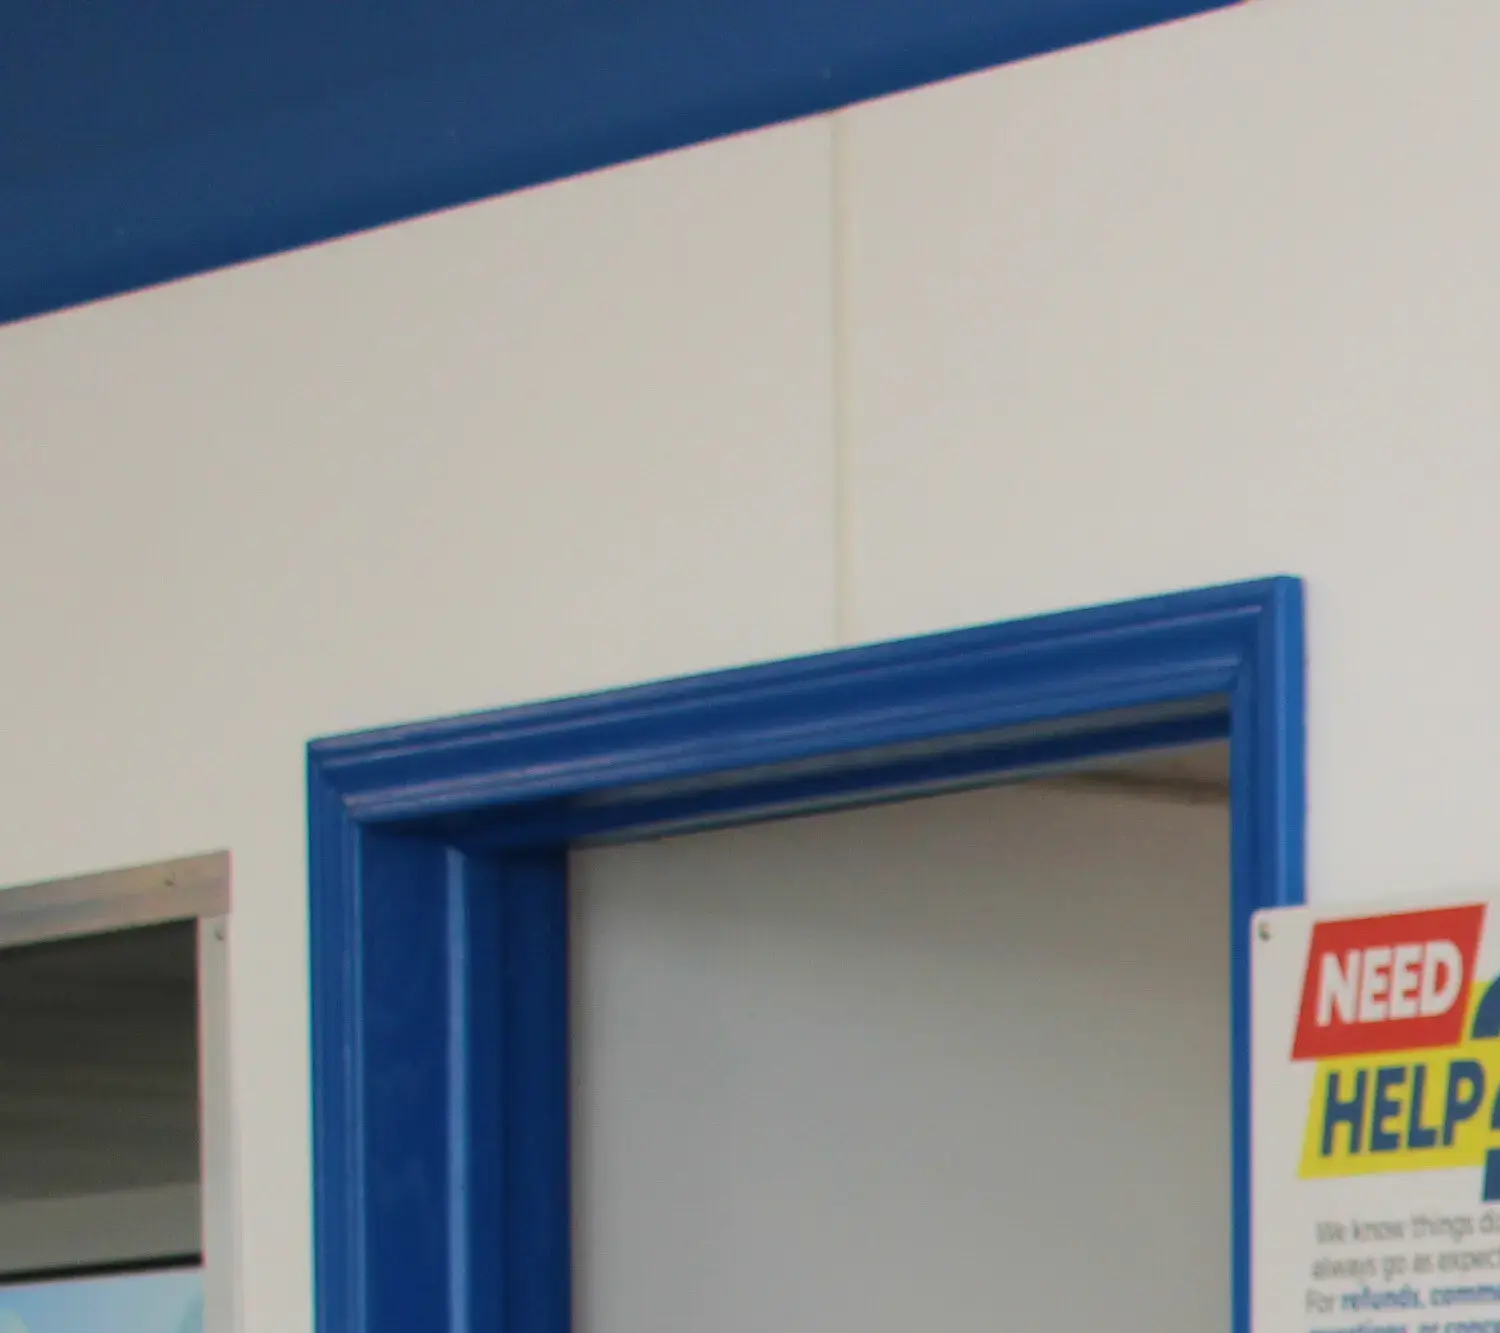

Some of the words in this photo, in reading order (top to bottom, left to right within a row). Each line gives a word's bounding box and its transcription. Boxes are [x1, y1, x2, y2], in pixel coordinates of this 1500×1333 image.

[1316, 940, 1465, 1027] NEED
[1352, 1217, 1404, 1241] know
[1410, 1211, 1474, 1245] things
[1311, 1253, 1376, 1281] always
[1382, 1252, 1405, 1282] go
[1412, 1253, 1434, 1274] as
[1306, 1288, 1335, 1313] For
